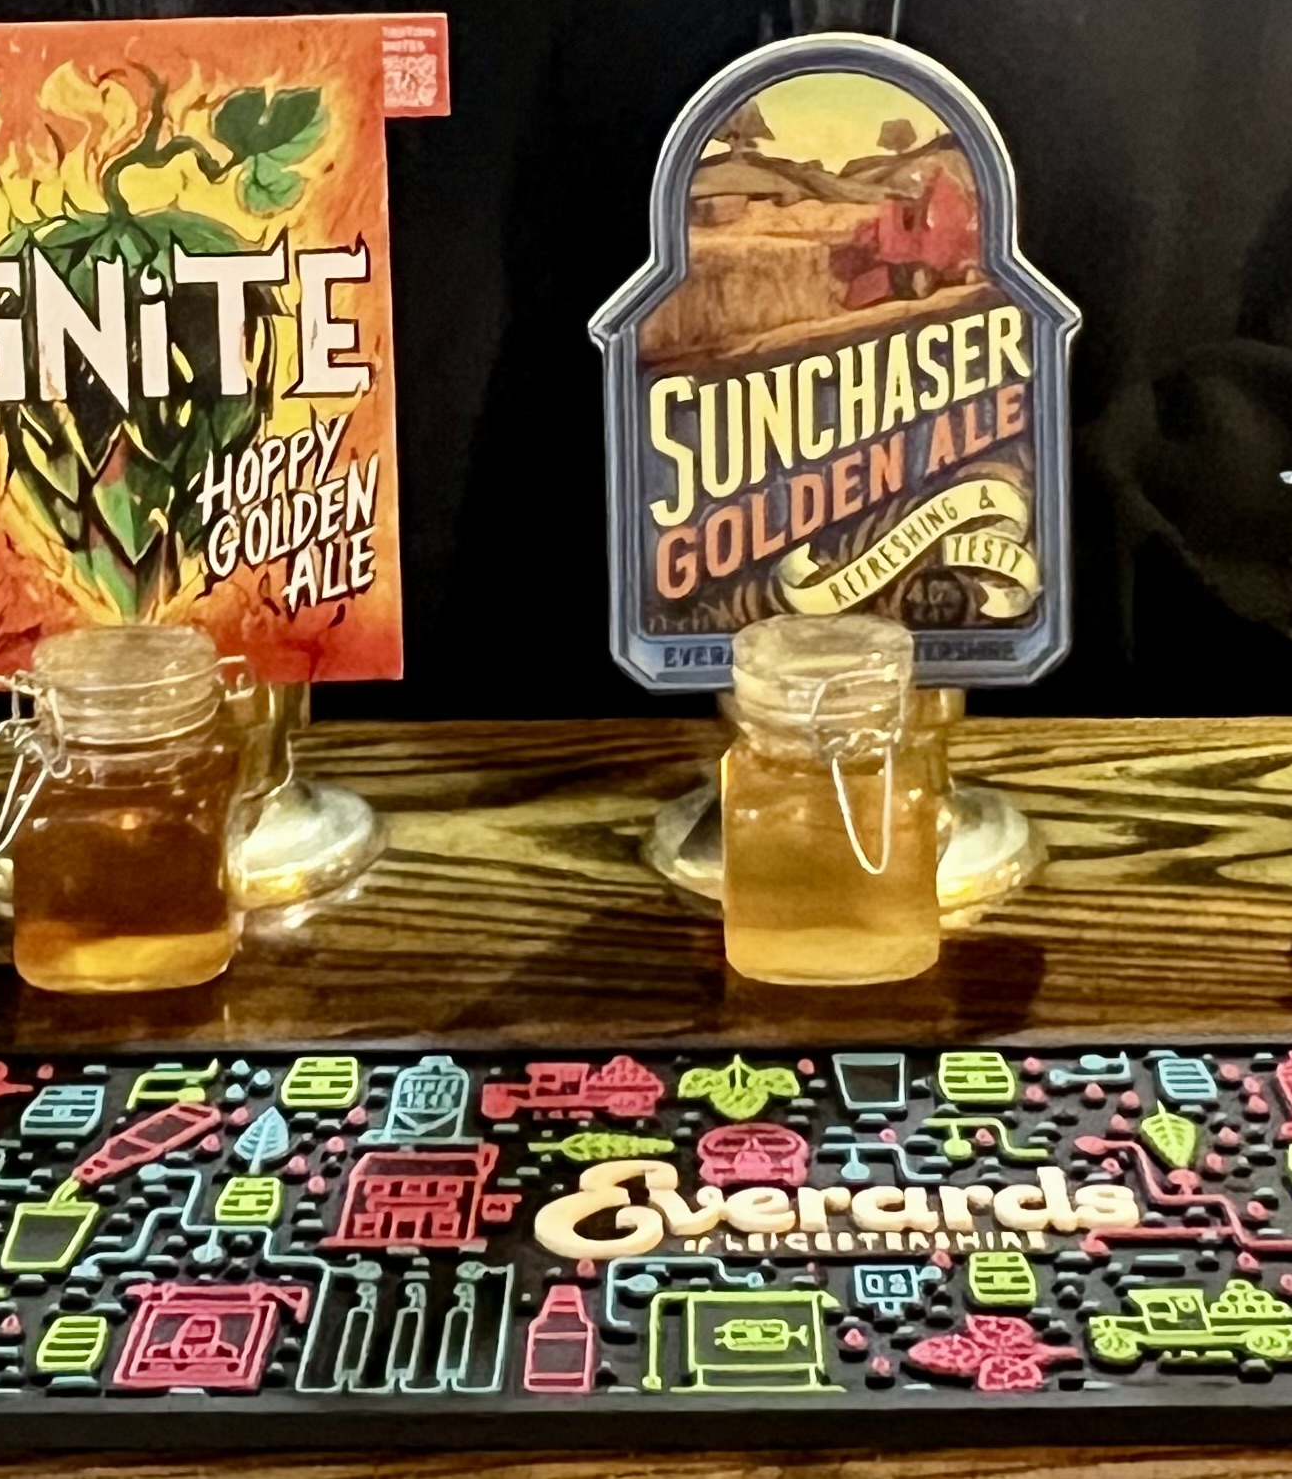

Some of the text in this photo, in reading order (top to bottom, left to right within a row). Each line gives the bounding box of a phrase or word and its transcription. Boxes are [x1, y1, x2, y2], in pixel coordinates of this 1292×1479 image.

[196, 414, 348, 526] HOPPY
[649, 305, 1032, 526] SUNCHASER
[208, 453, 380, 578] GOLDEN
[655, 385, 1026, 600] GOLDEN ALE
[828, 484, 996, 607] REFRESHING &
[282, 526, 378, 614] ALE
[534, 1158, 1141, 1259] Everards
